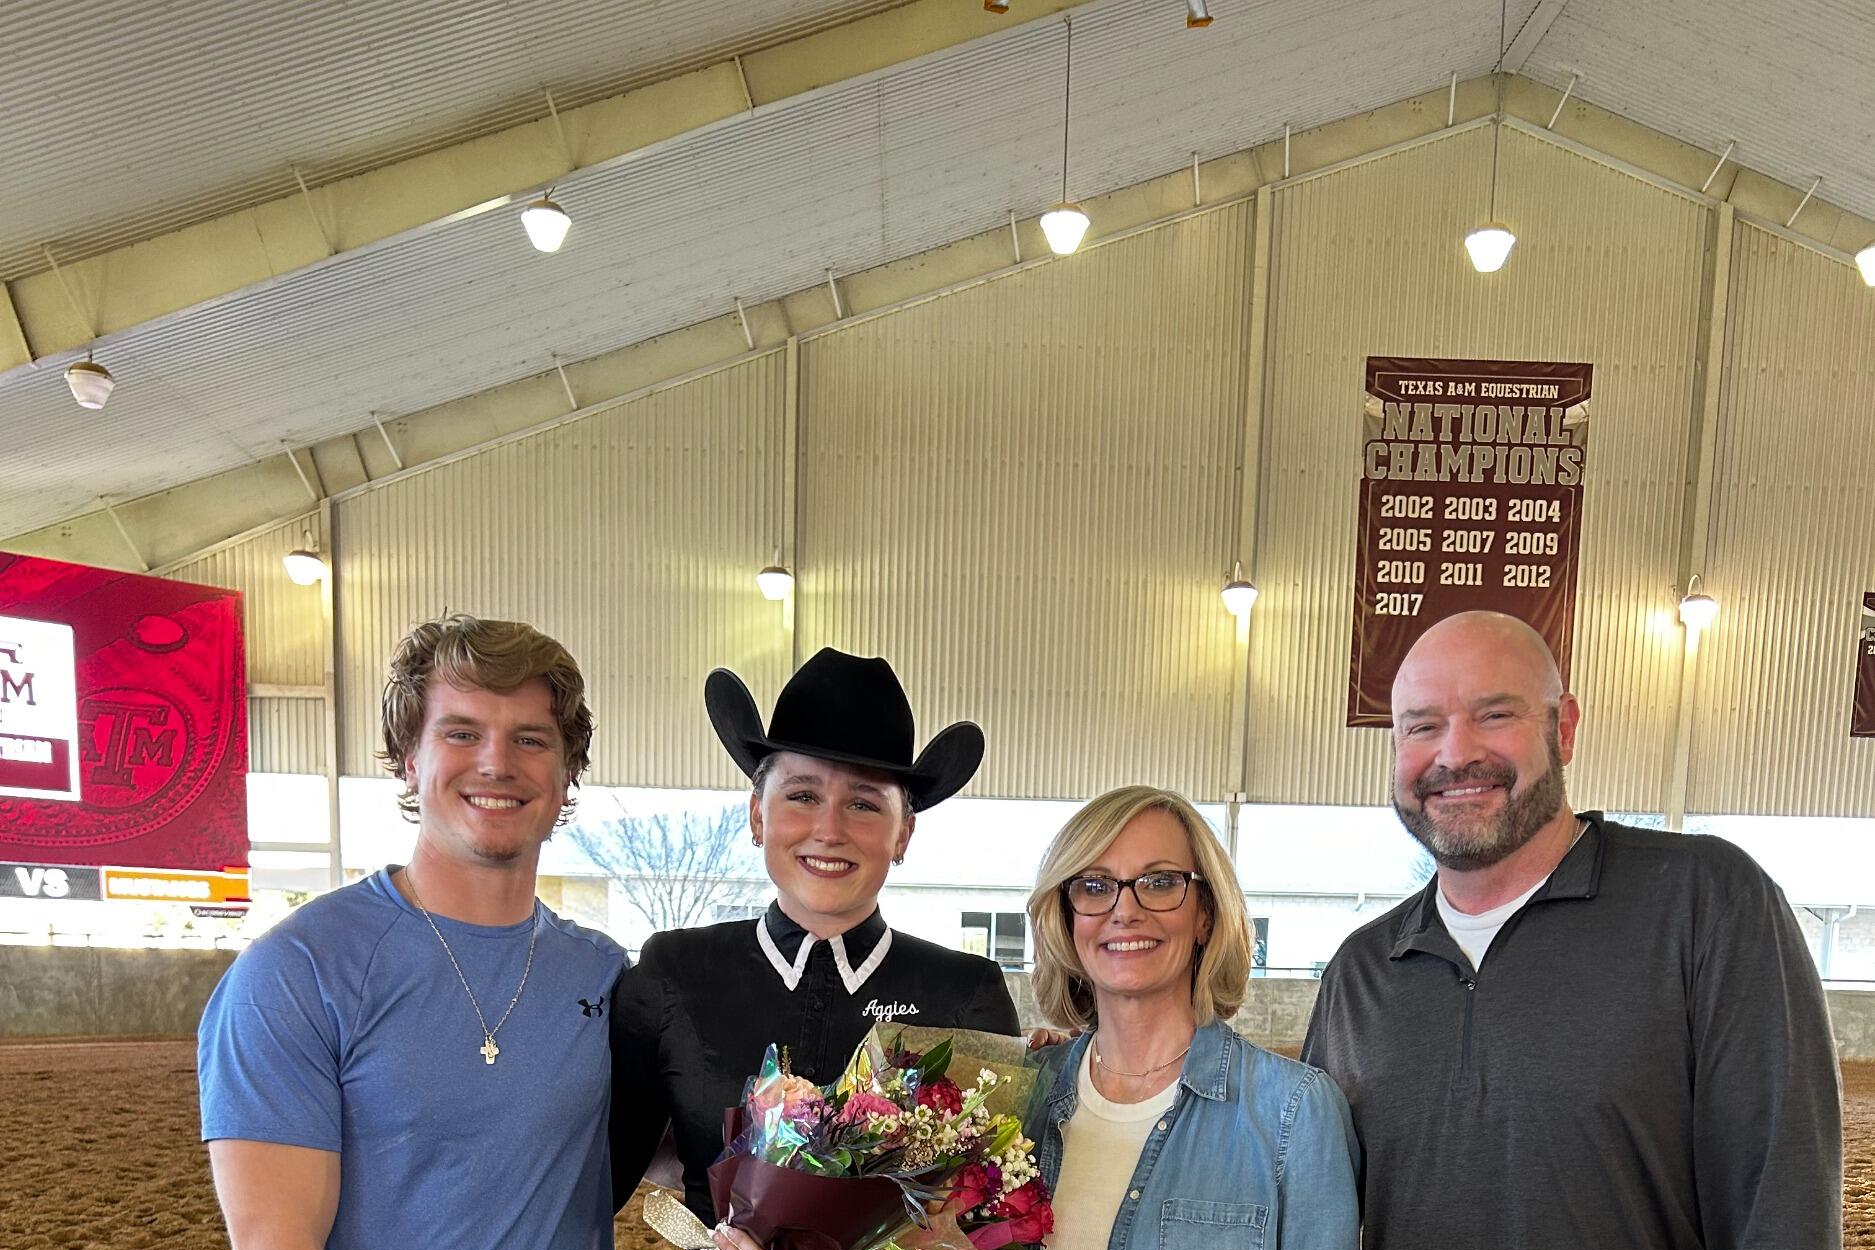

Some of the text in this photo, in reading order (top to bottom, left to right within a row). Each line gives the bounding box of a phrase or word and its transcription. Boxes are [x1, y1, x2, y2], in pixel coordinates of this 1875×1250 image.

[1399, 380, 1559, 399] TEXAS A&M EQUESTRIAN
[1383, 402, 1570, 445] NATIONAL
[1365, 442, 1582, 486] CHAMPIONS
[1380, 494, 1561, 522] 2002 2003 2004
[1378, 528, 1558, 555] 2005 2007 2009
[1376, 560, 1551, 588] 2010 2011 2012
[1375, 592, 1424, 616] 2017
[14, 867, 69, 898] VS
[862, 999, 919, 1022] Aggies
